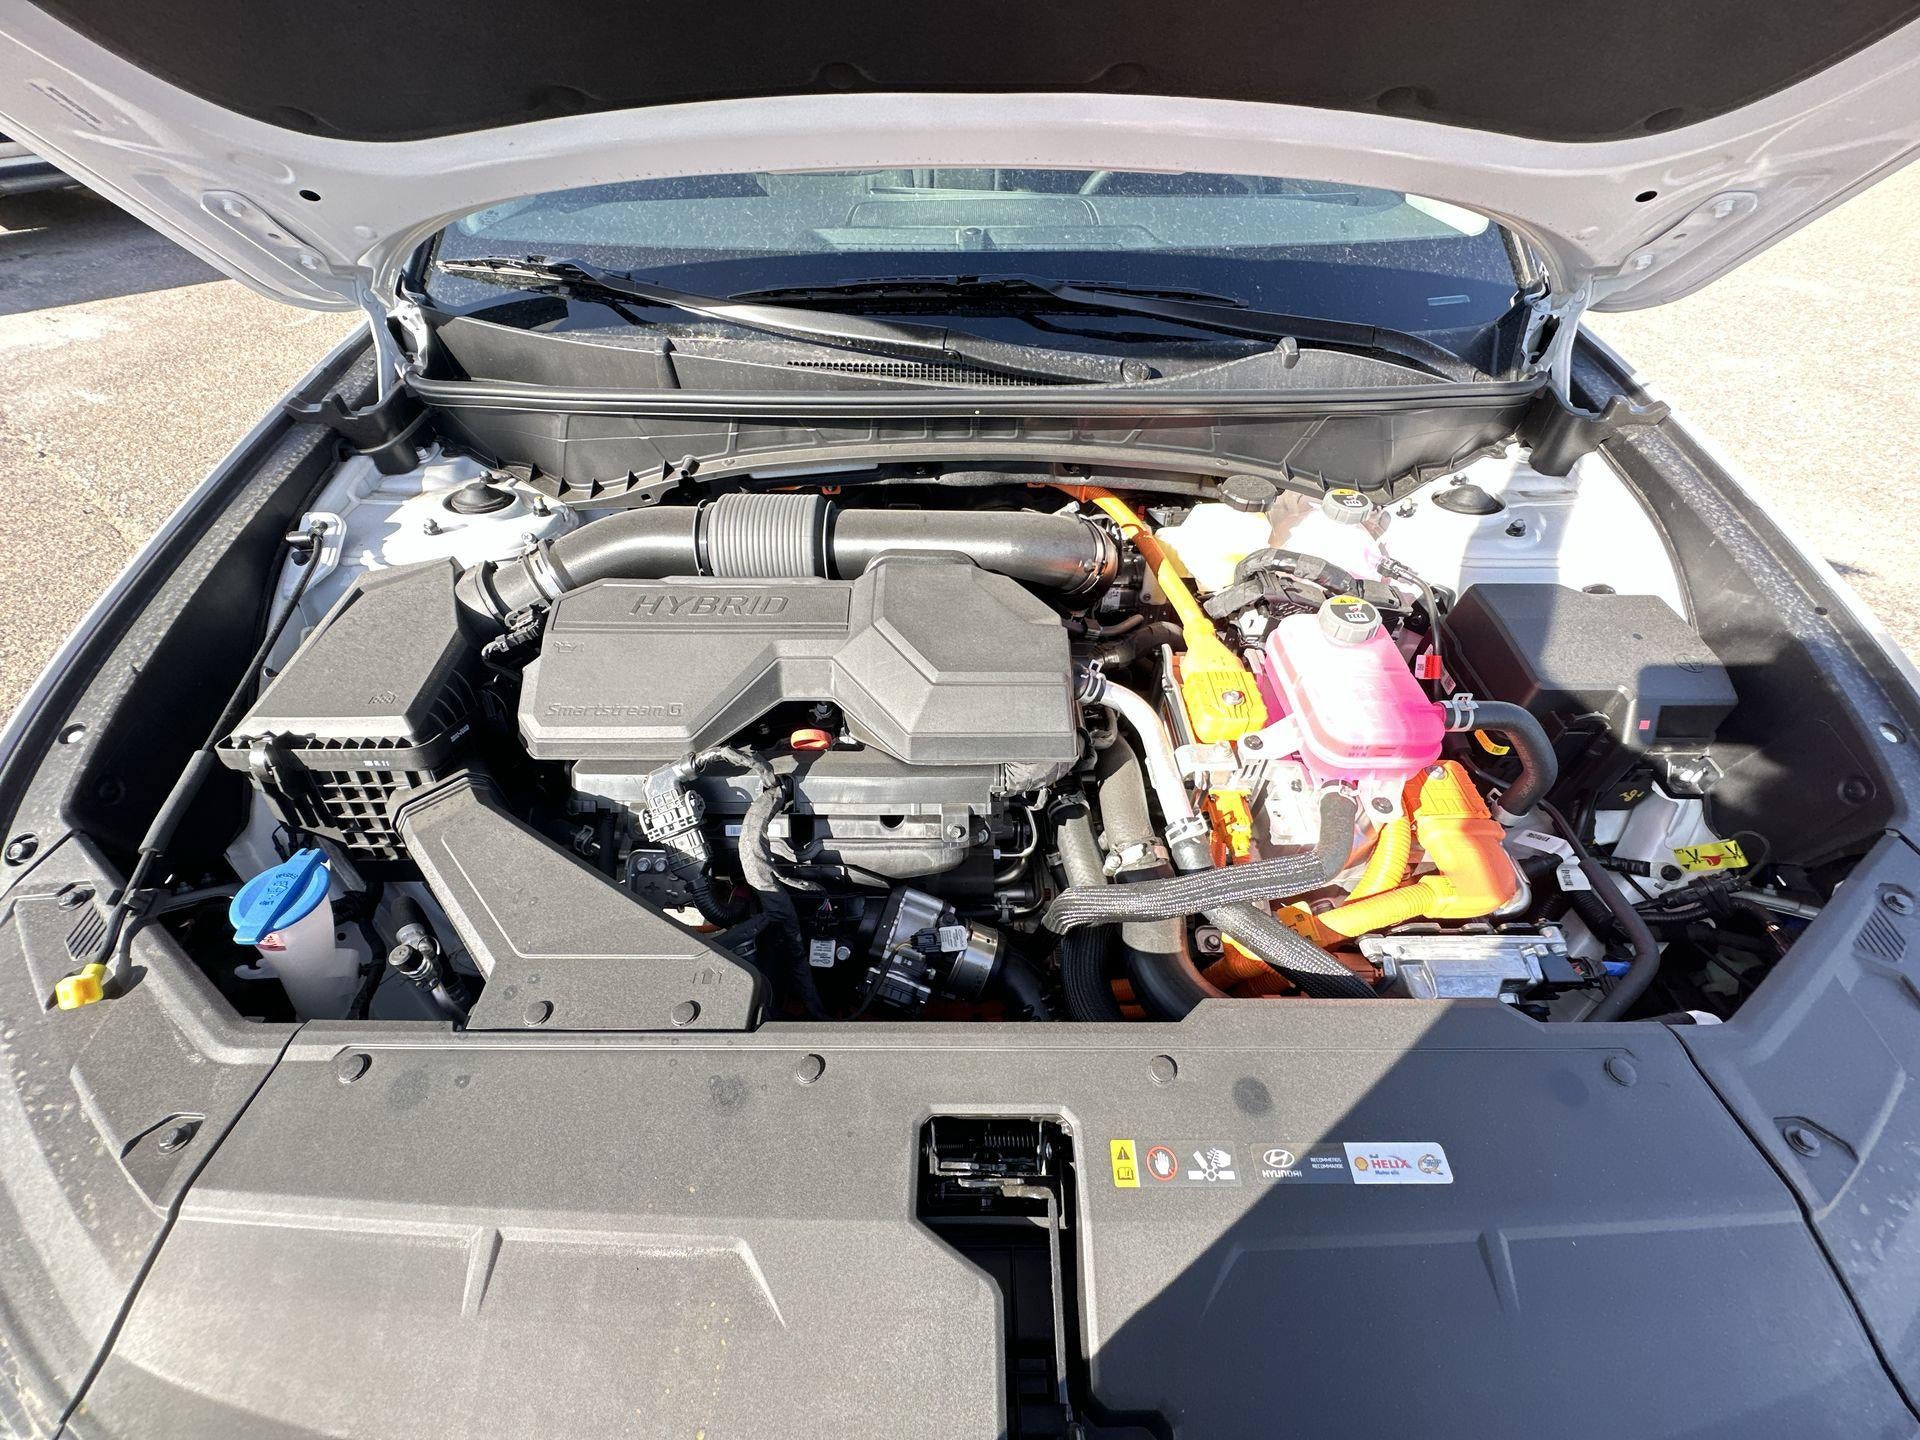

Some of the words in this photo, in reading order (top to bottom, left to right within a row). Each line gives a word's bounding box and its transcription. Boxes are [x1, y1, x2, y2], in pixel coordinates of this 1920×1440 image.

[629, 595, 789, 616] HYBRID
[546, 702, 665, 717] Smartstream
[667, 702, 684, 717] G
[1371, 1159, 1411, 1169] HELIX
[1262, 1169, 1303, 1179] HYUNDAI
